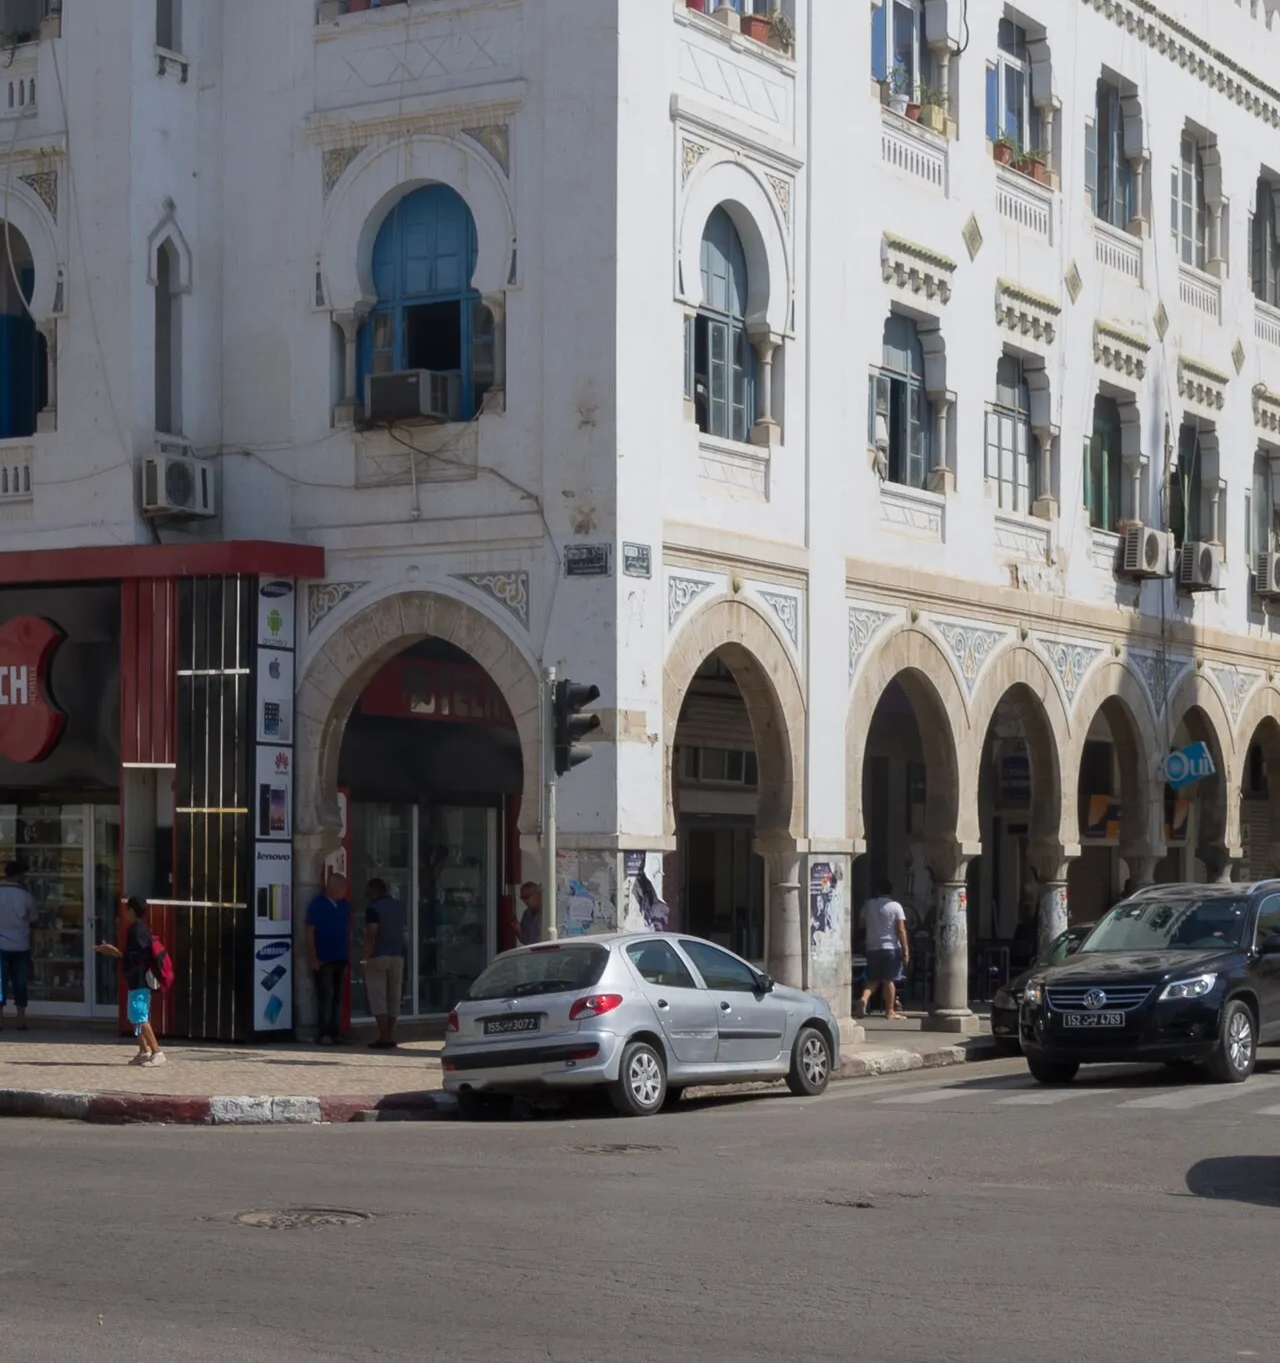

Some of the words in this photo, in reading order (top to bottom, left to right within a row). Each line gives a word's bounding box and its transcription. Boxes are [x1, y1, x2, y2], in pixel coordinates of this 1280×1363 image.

[1163, 750, 1209, 782] Oui
[256, 851, 290, 861] lenovo
[487, 1021, 500, 1033] 155
[513, 1018, 535, 1030] 3072
[1067, 1015, 1081, 1025] 152
[1100, 1014, 1121, 1025] 4769
